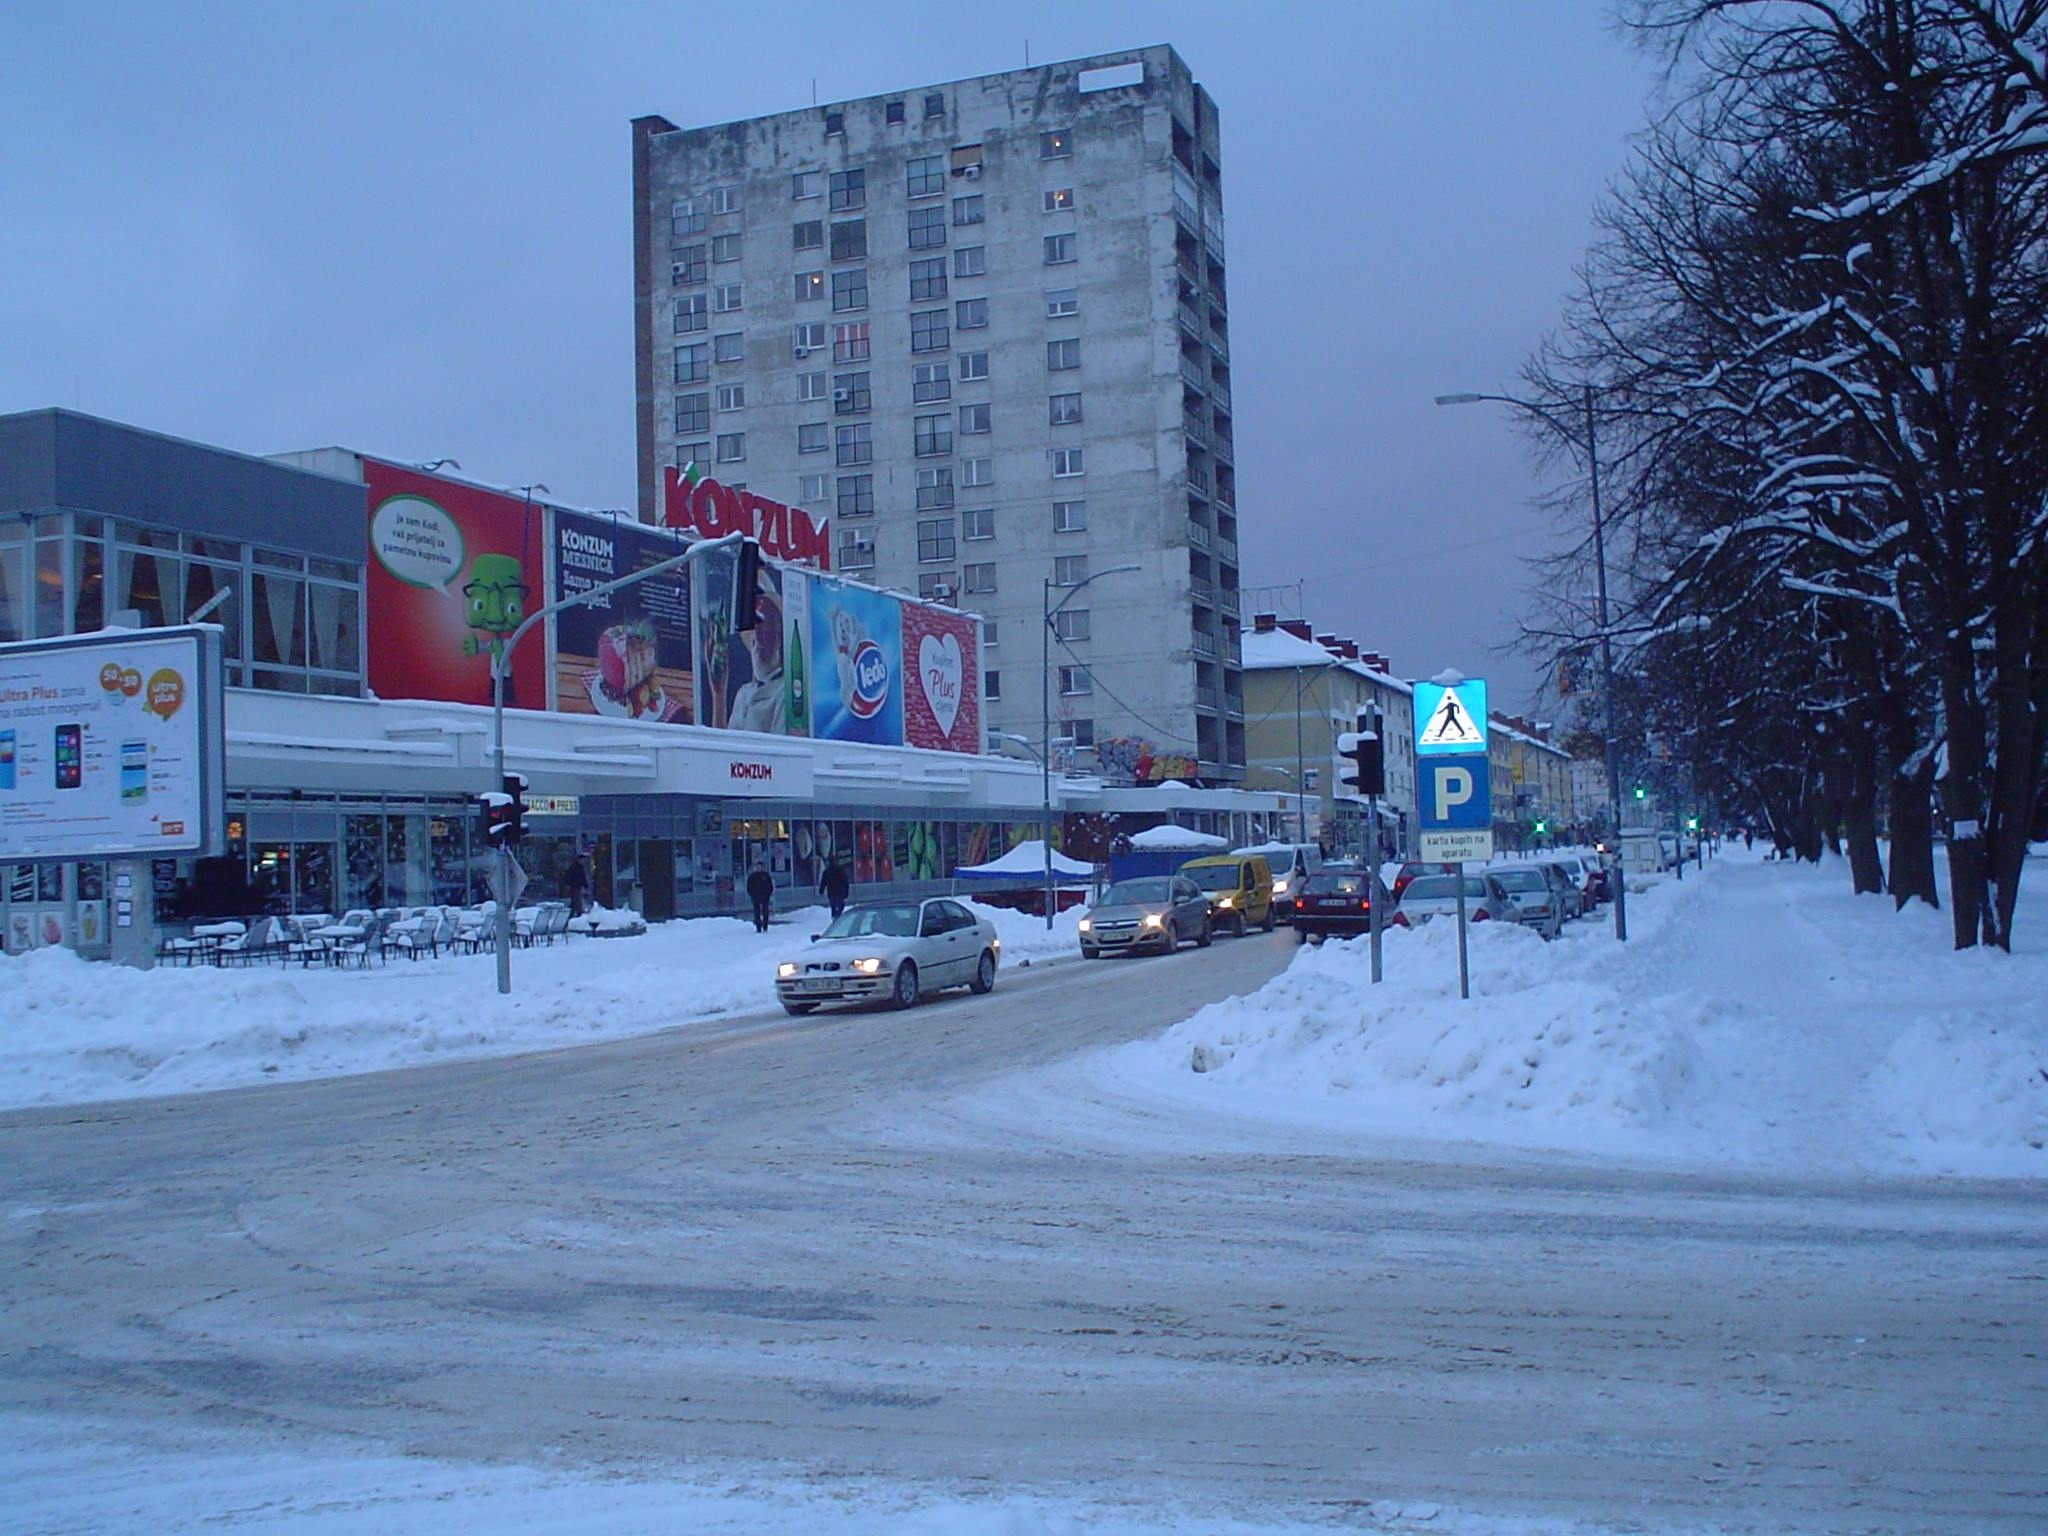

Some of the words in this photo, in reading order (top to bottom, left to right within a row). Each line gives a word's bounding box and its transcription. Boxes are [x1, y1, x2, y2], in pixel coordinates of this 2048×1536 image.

[405, 517, 421, 526] sam
[664, 462, 831, 571] KONZUM
[562, 529, 614, 558] KONZUM
[563, 549, 614, 574] MESNICA
[563, 570, 592, 590] Samo
[104, 670, 118, 681] 50
[860, 657, 886, 689] ledo
[152, 682, 178, 693] ultra
[928, 669, 955, 699] Plus
[32, 685, 58, 699] Plus
[154, 693, 176, 705] plus
[13, 705, 46, 718] radost
[730, 762, 772, 780] KONZUM
[1435, 766, 1473, 820] P
[556, 799, 578, 812] PRESS
[1427, 835, 1449, 845] kartu
[1450, 834, 1473, 846] kupiti
[1474, 835, 1485, 844] na
[1441, 848, 1472, 859] aparatu
